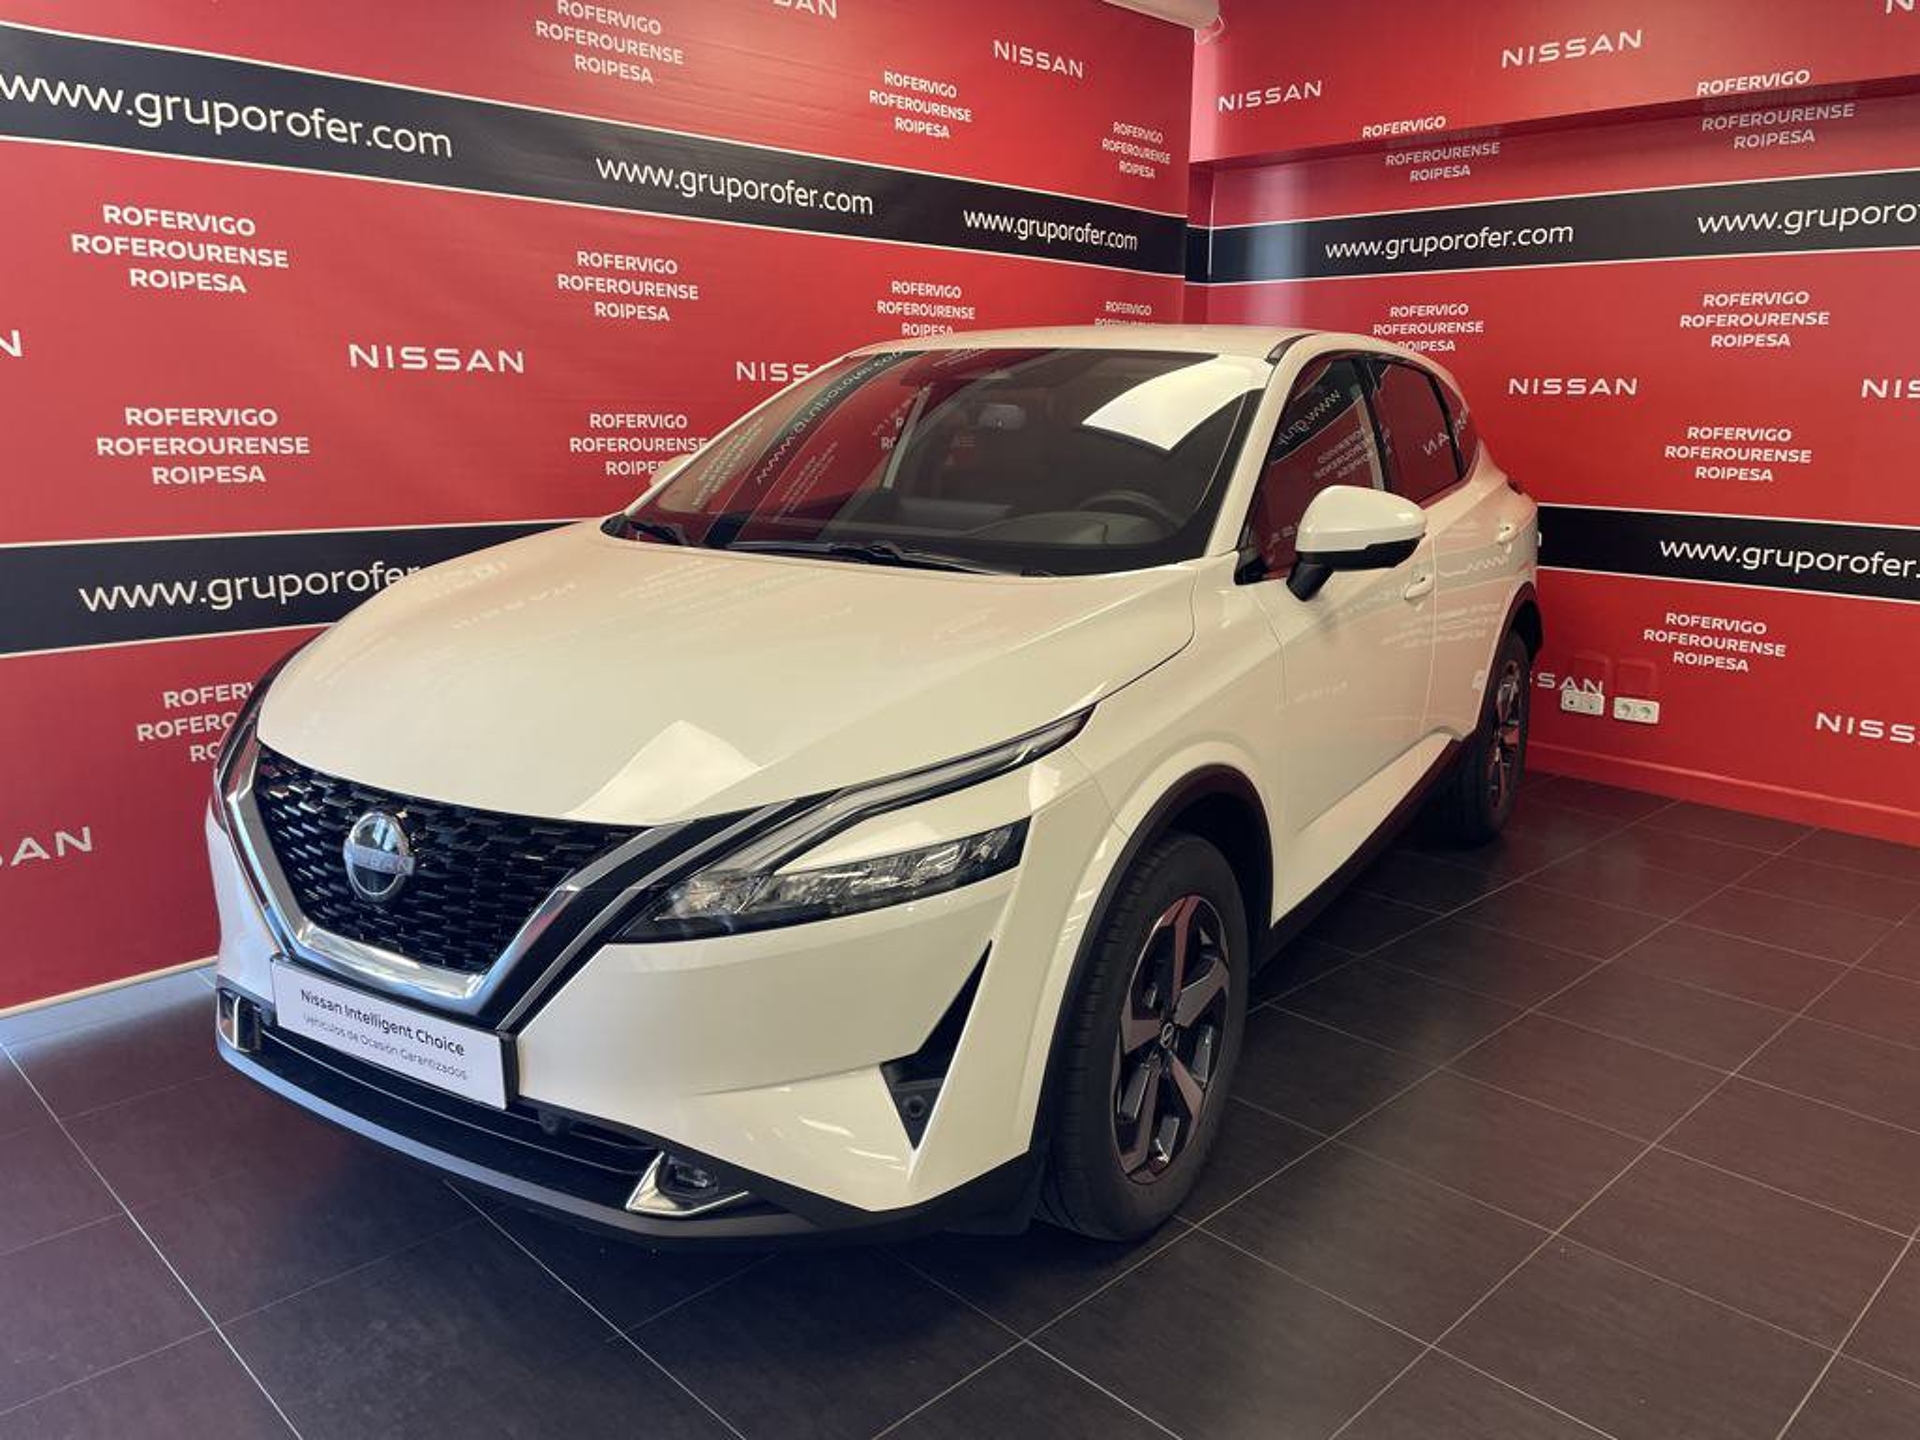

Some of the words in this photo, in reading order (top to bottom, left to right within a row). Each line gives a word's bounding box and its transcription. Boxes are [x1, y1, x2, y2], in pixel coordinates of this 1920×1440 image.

[558, 0, 661, 35] ROFERVIGO
[536, 21, 683, 64] ROFEROURENSE
[1502, 30, 1641, 67] NISSAN
[575, 54, 653, 83] ROIPESA
[994, 40, 1082, 78] NISSAN
[884, 71, 956, 98] ROFERVIGO
[1697, 70, 1809, 96] ROFERVIGO
[870, 90, 971, 122] ROFEROURENSE
[1217, 80, 1322, 111] NISSAN
[0, 74, 451, 157] www.gruporofer.com
[895, 117, 949, 137] ROIPESA
[1363, 116, 1446, 138] ROFERVIGO
[1702, 103, 1854, 131] ROFEROURENSE
[1734, 129, 1815, 149] ROIPESA
[1386, 142, 1500, 165] ROFEROURENSE
[1410, 165, 1470, 181] ROIPESA
[596, 158, 872, 214] www.gruporofer.com
[103, 205, 255, 236] ROFERVIGO
[964, 210, 1137, 250] www.gruporofer.com
[1698, 204, 1920, 234] www.gruporo
[72, 234, 288, 267] ROFEROURENSE
[1325, 226, 1573, 259] www.gruporofer.com
[577, 251, 677, 274] ROFERVIGO
[130, 269, 246, 293] ROIPESA
[558, 274, 698, 299] ROFEROURENSE
[892, 281, 961, 298] ROFERVIGO
[877, 300, 975, 319] ROFEROURENSE
[1703, 291, 1809, 306] ROFERVIGO
[595, 302, 669, 321] ROIPESA
[1390, 304, 1468, 317] ROFERVIGO
[1680, 312, 1830, 327] ROFEROURENSE
[1373, 321, 1483, 335] ROFEROURENSE
[1711, 334, 1790, 347] ROIPESA
[349, 344, 523, 373] NISSAN
[1509, 378, 1637, 395] NISSAN
[125, 408, 277, 426] ROFERVIGO
[590, 414, 687, 428] ROFERVIGO
[1688, 427, 1791, 441] ROFERVIGO
[97, 437, 309, 455] ROFEROURENSE
[1665, 446, 1812, 463] ROFEROURENSE
[152, 466, 266, 484] ROIPESA
[1696, 467, 1772, 481] ROIPESA
[1666, 613, 1766, 634] ROFERVIGO
[1644, 629, 1786, 657] ROFEROURENSE
[1674, 652, 1748, 672] ROIPESA
[1530, 672, 1603, 694] SAN
[1816, 712, 1920, 744] NISS
[301, 989, 343, 1015] Nissan
[345, 1004, 413, 1040] Intelligent
[416, 1029, 465, 1056] Choice
